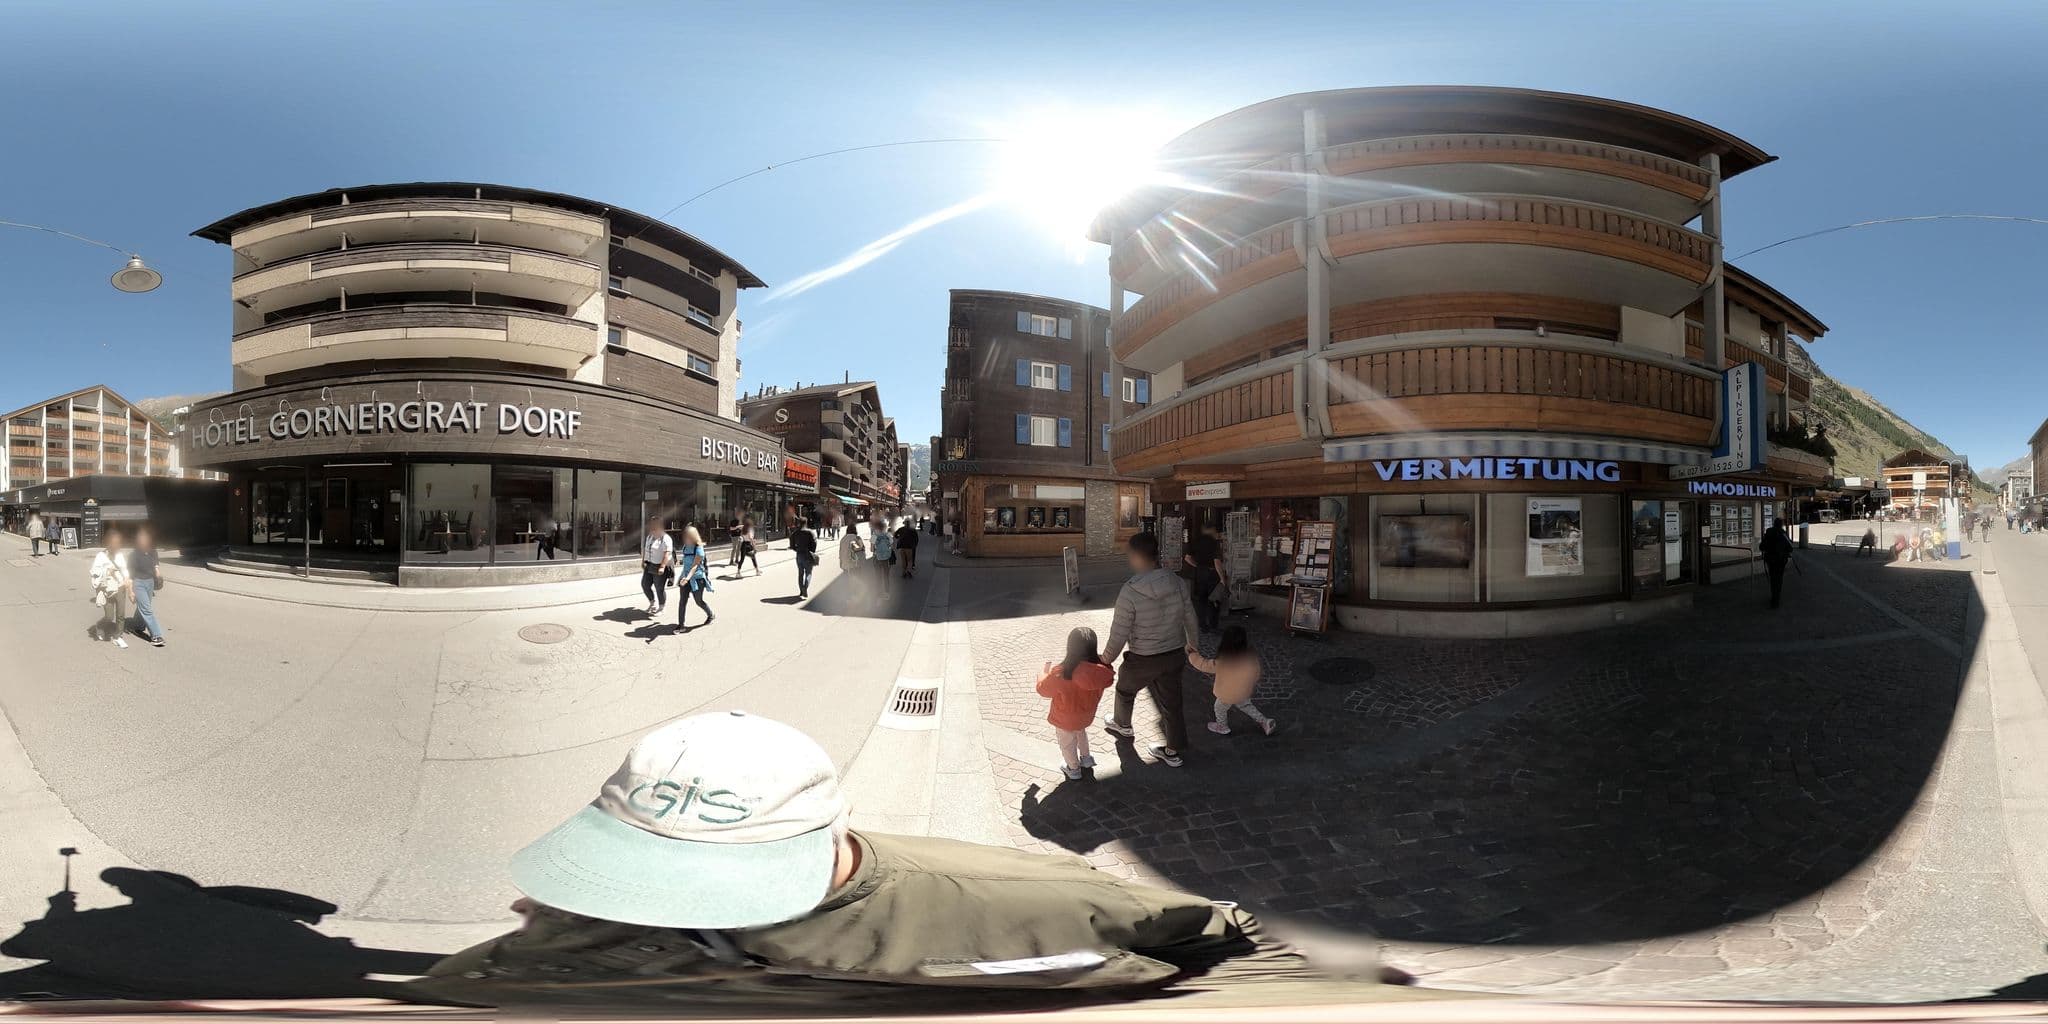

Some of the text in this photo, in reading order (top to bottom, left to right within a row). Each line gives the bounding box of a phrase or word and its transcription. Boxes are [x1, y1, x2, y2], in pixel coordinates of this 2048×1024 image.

[191, 402, 582, 449] HOTEL GORNERGRAT DORF
[1735, 369, 1744, 468] ALPINCERVINO
[702, 436, 751, 464] BISTRO
[757, 450, 778, 471] BAR
[1713, 463, 1721, 471] 15
[1723, 461, 1732, 470] 25
[1373, 457, 1621, 482] VERMIETUNG
[1688, 481, 1777, 497] IMMOBILIEN
